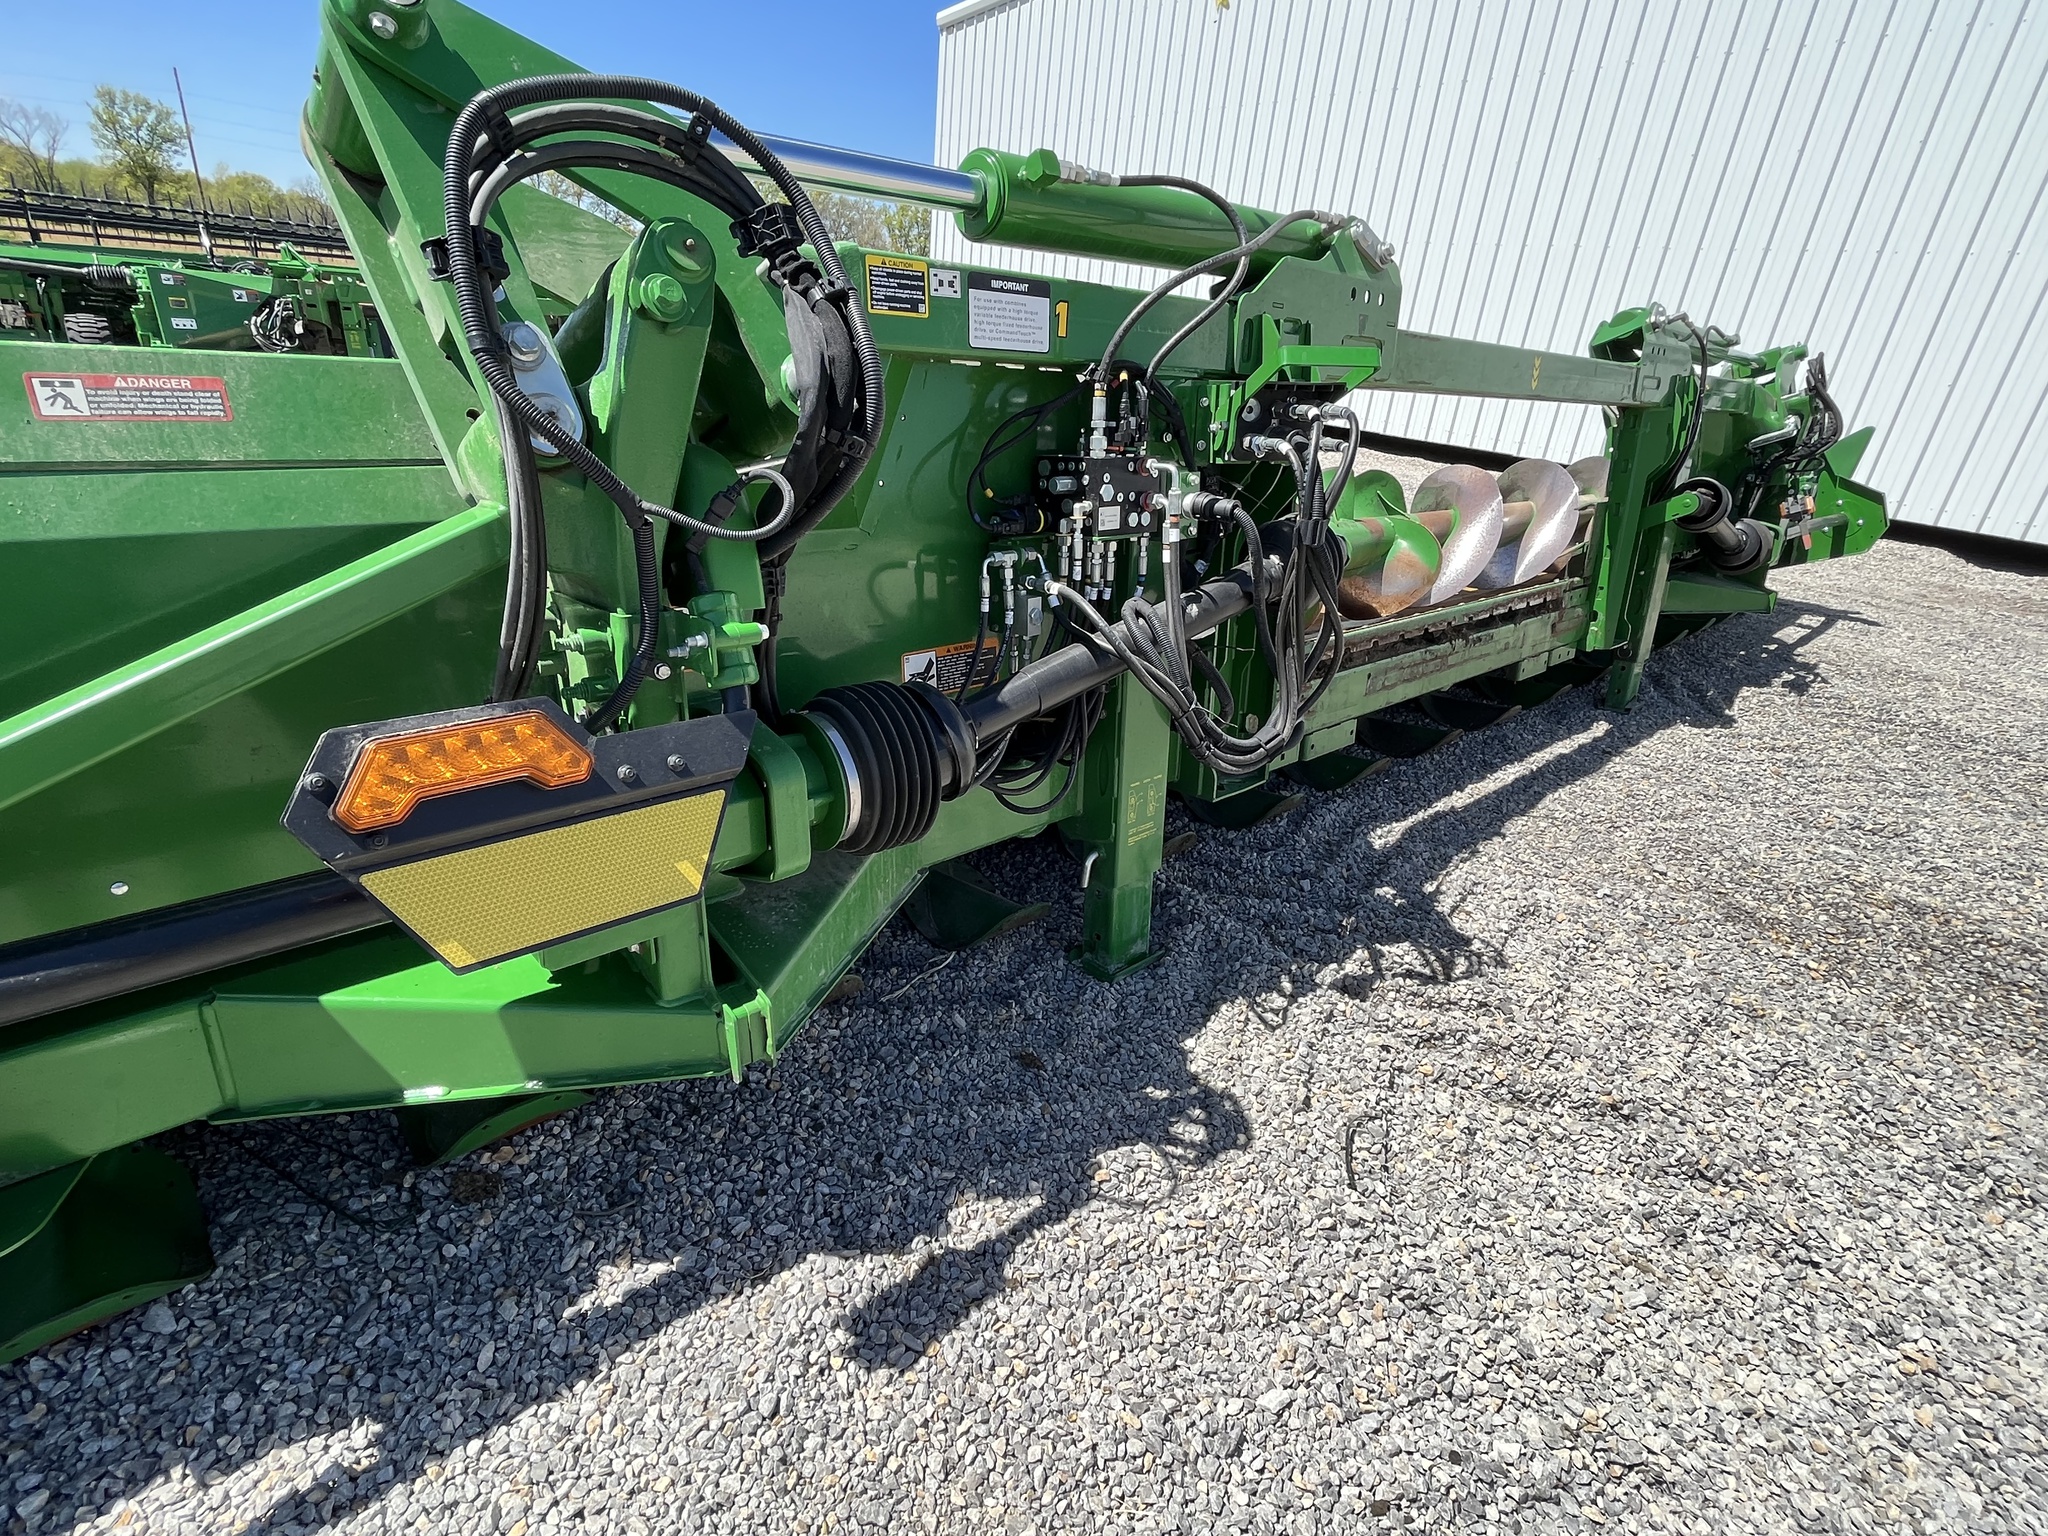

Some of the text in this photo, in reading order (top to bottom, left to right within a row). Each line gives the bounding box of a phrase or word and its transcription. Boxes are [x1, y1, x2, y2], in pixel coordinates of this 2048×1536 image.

[888, 260, 914, 268] CAUTION
[991, 280, 1029, 292] IMPORTANT
[1055, 300, 1069, 338] 1
[126, 377, 191, 389] DANGER
